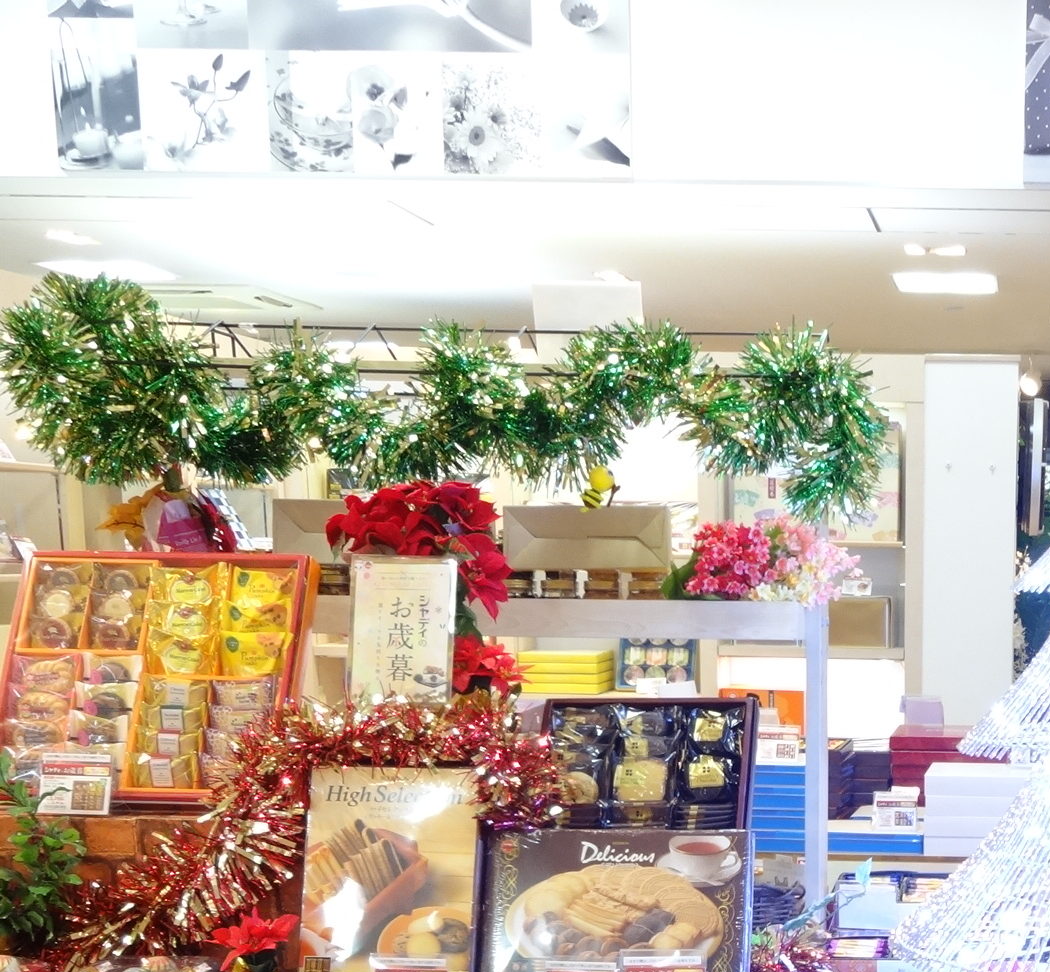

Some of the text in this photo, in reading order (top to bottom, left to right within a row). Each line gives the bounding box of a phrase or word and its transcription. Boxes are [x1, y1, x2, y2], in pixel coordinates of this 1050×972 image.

[387, 597, 415, 682] お歳暮
[326, 785, 463, 807] High Selecn
[580, 841, 656, 864] Delicious
